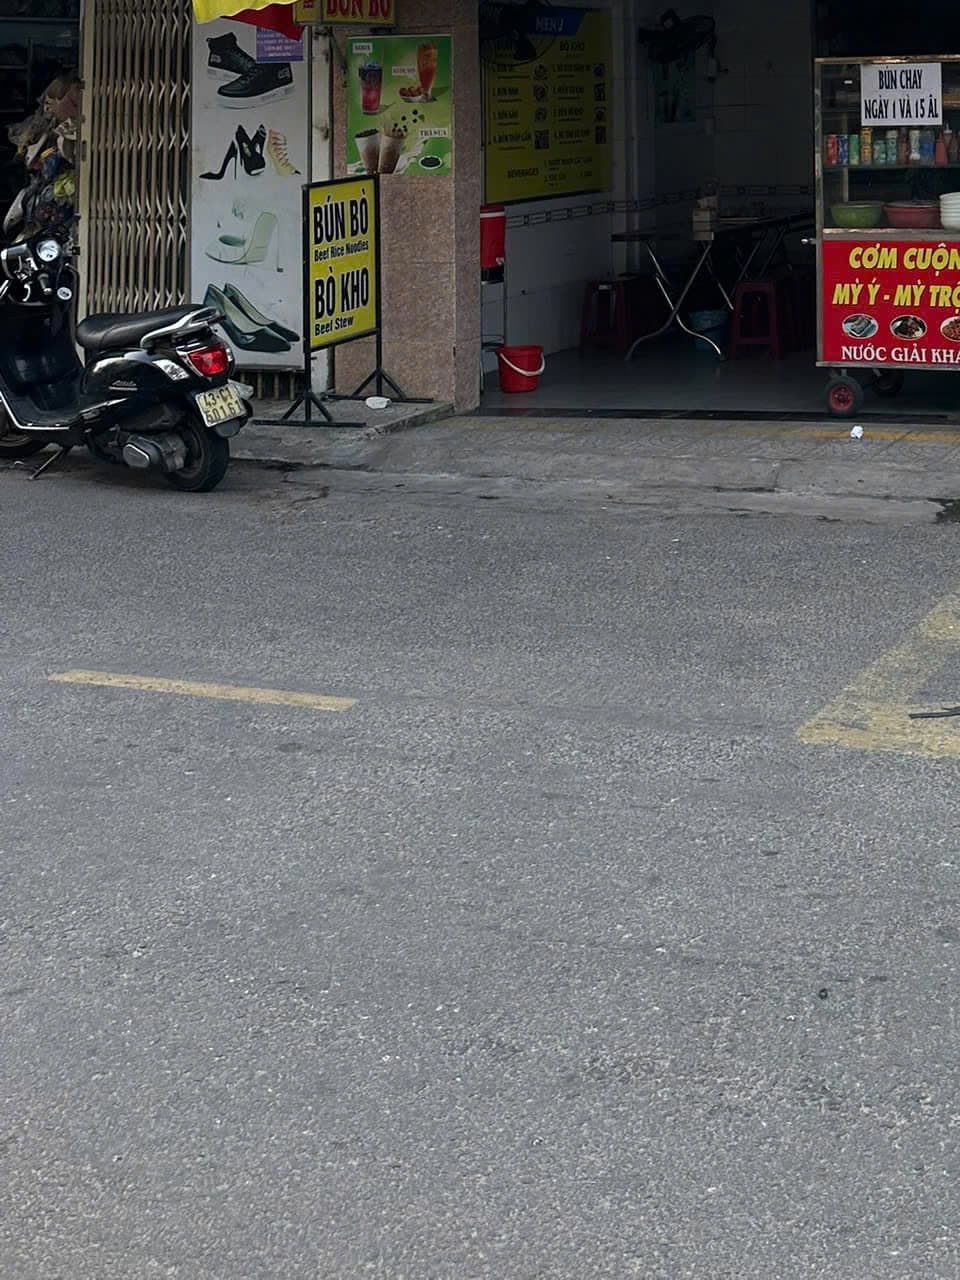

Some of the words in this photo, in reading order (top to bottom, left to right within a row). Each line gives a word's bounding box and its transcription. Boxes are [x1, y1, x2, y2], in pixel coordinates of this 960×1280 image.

[878, 65, 897, 90] BÚN
[899, 69, 923, 90] CHAY
[864, 95, 889, 120] NGÀY
[899, 95, 912, 119] VÀ
[914, 98, 926, 118] 15
[313, 196, 346, 245] BÚN
[350, 188, 369, 237] BÒ
[314, 247, 330, 262] Beef
[330, 244, 345, 258] Rice
[345, 239, 369, 256] Noodles
[849, 242, 898, 270] CƠM
[315, 266, 336, 320] BÒ
[340, 267, 369, 313] KHO
[867, 277, 881, 305] Ý
[314, 321, 333, 337] Beef
[334, 314, 354, 331] Stew
[841, 341, 887, 362] NƯỚC
[891, 342, 926, 363] GIẢI
